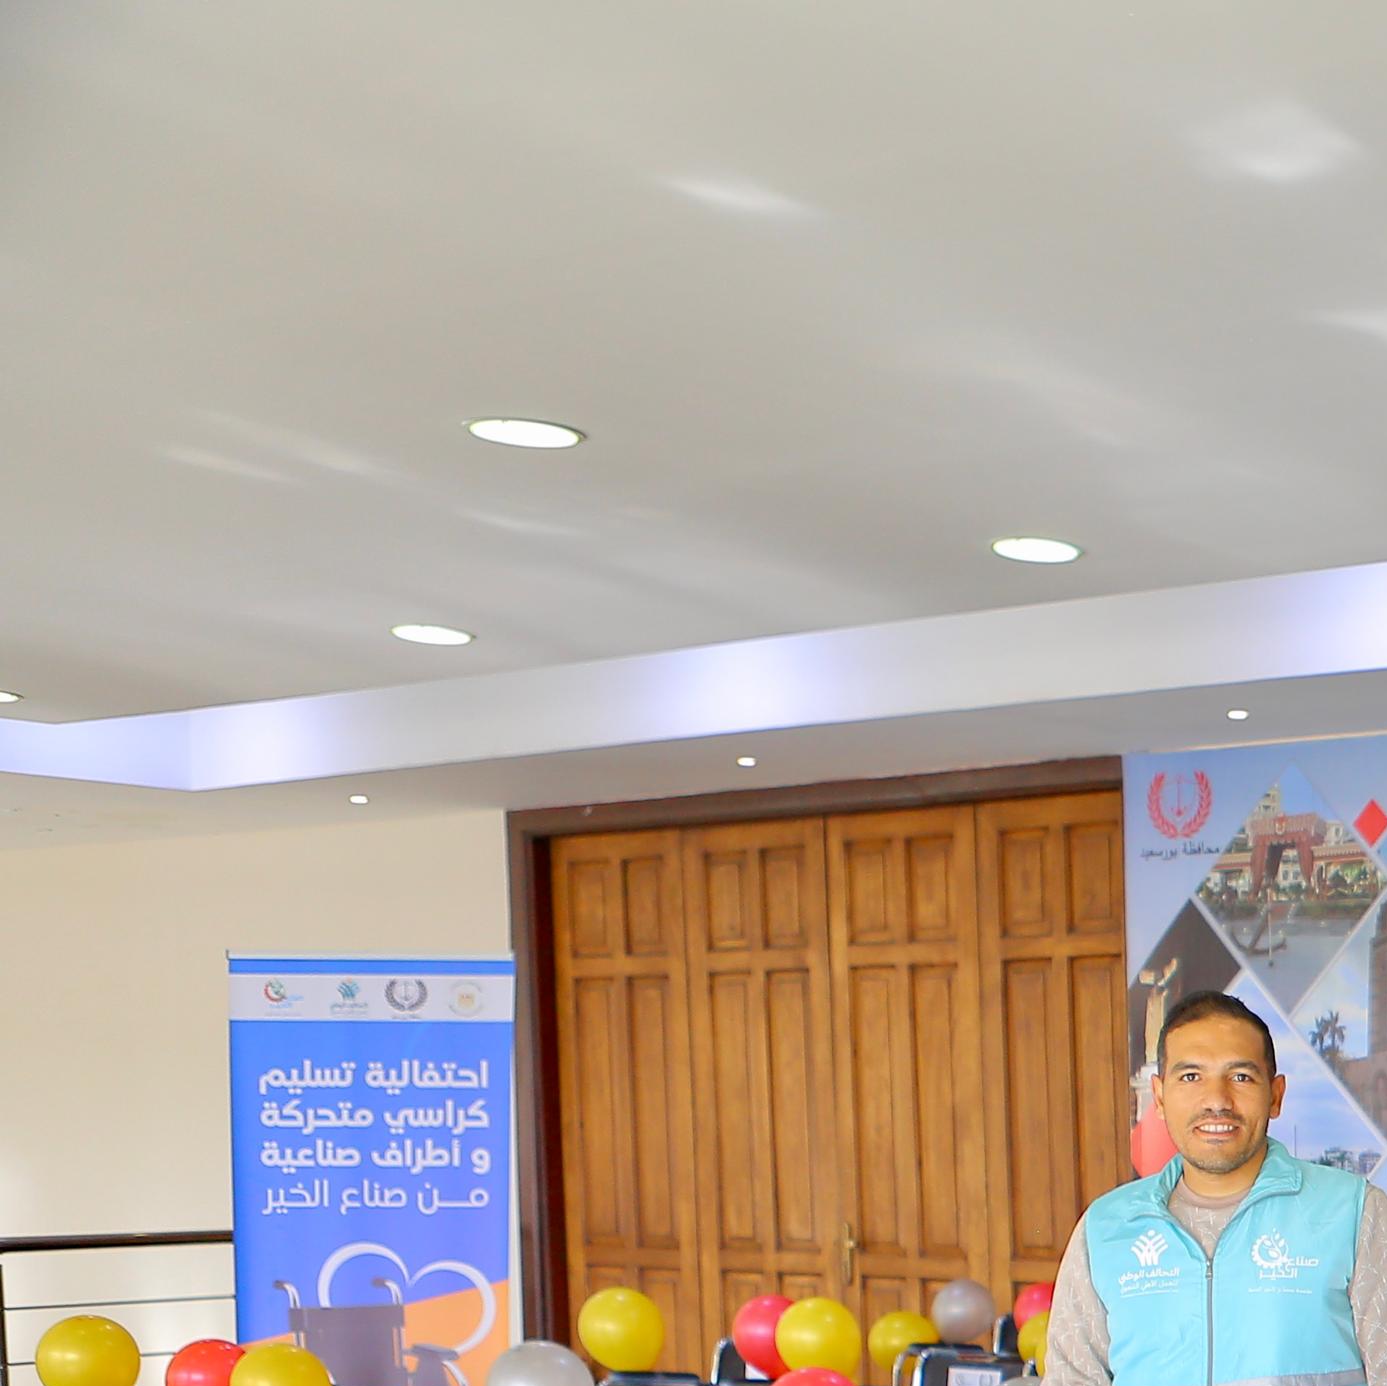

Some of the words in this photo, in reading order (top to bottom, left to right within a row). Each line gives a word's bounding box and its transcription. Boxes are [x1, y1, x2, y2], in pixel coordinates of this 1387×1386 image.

[258, 1059, 357, 1096] تسليم
[364, 1059, 489, 1096] احتفالية
[259, 1099, 375, 1136] متحركة
[382, 1098, 491, 1135] كراسي
[260, 1138, 362, 1174] صناعية
[370, 1138, 462, 1175] أطراف
[470, 1147, 492, 1175] و
[261, 1178, 330, 1216] الخير
[339, 1177, 408, 1216] صناع
[416, 1181, 490, 1216] من
[1145, 1266, 1181, 1278] التحالف
[1259, 1267, 1298, 1281] الخير
[1285, 1255, 1320, 1273] صناع
